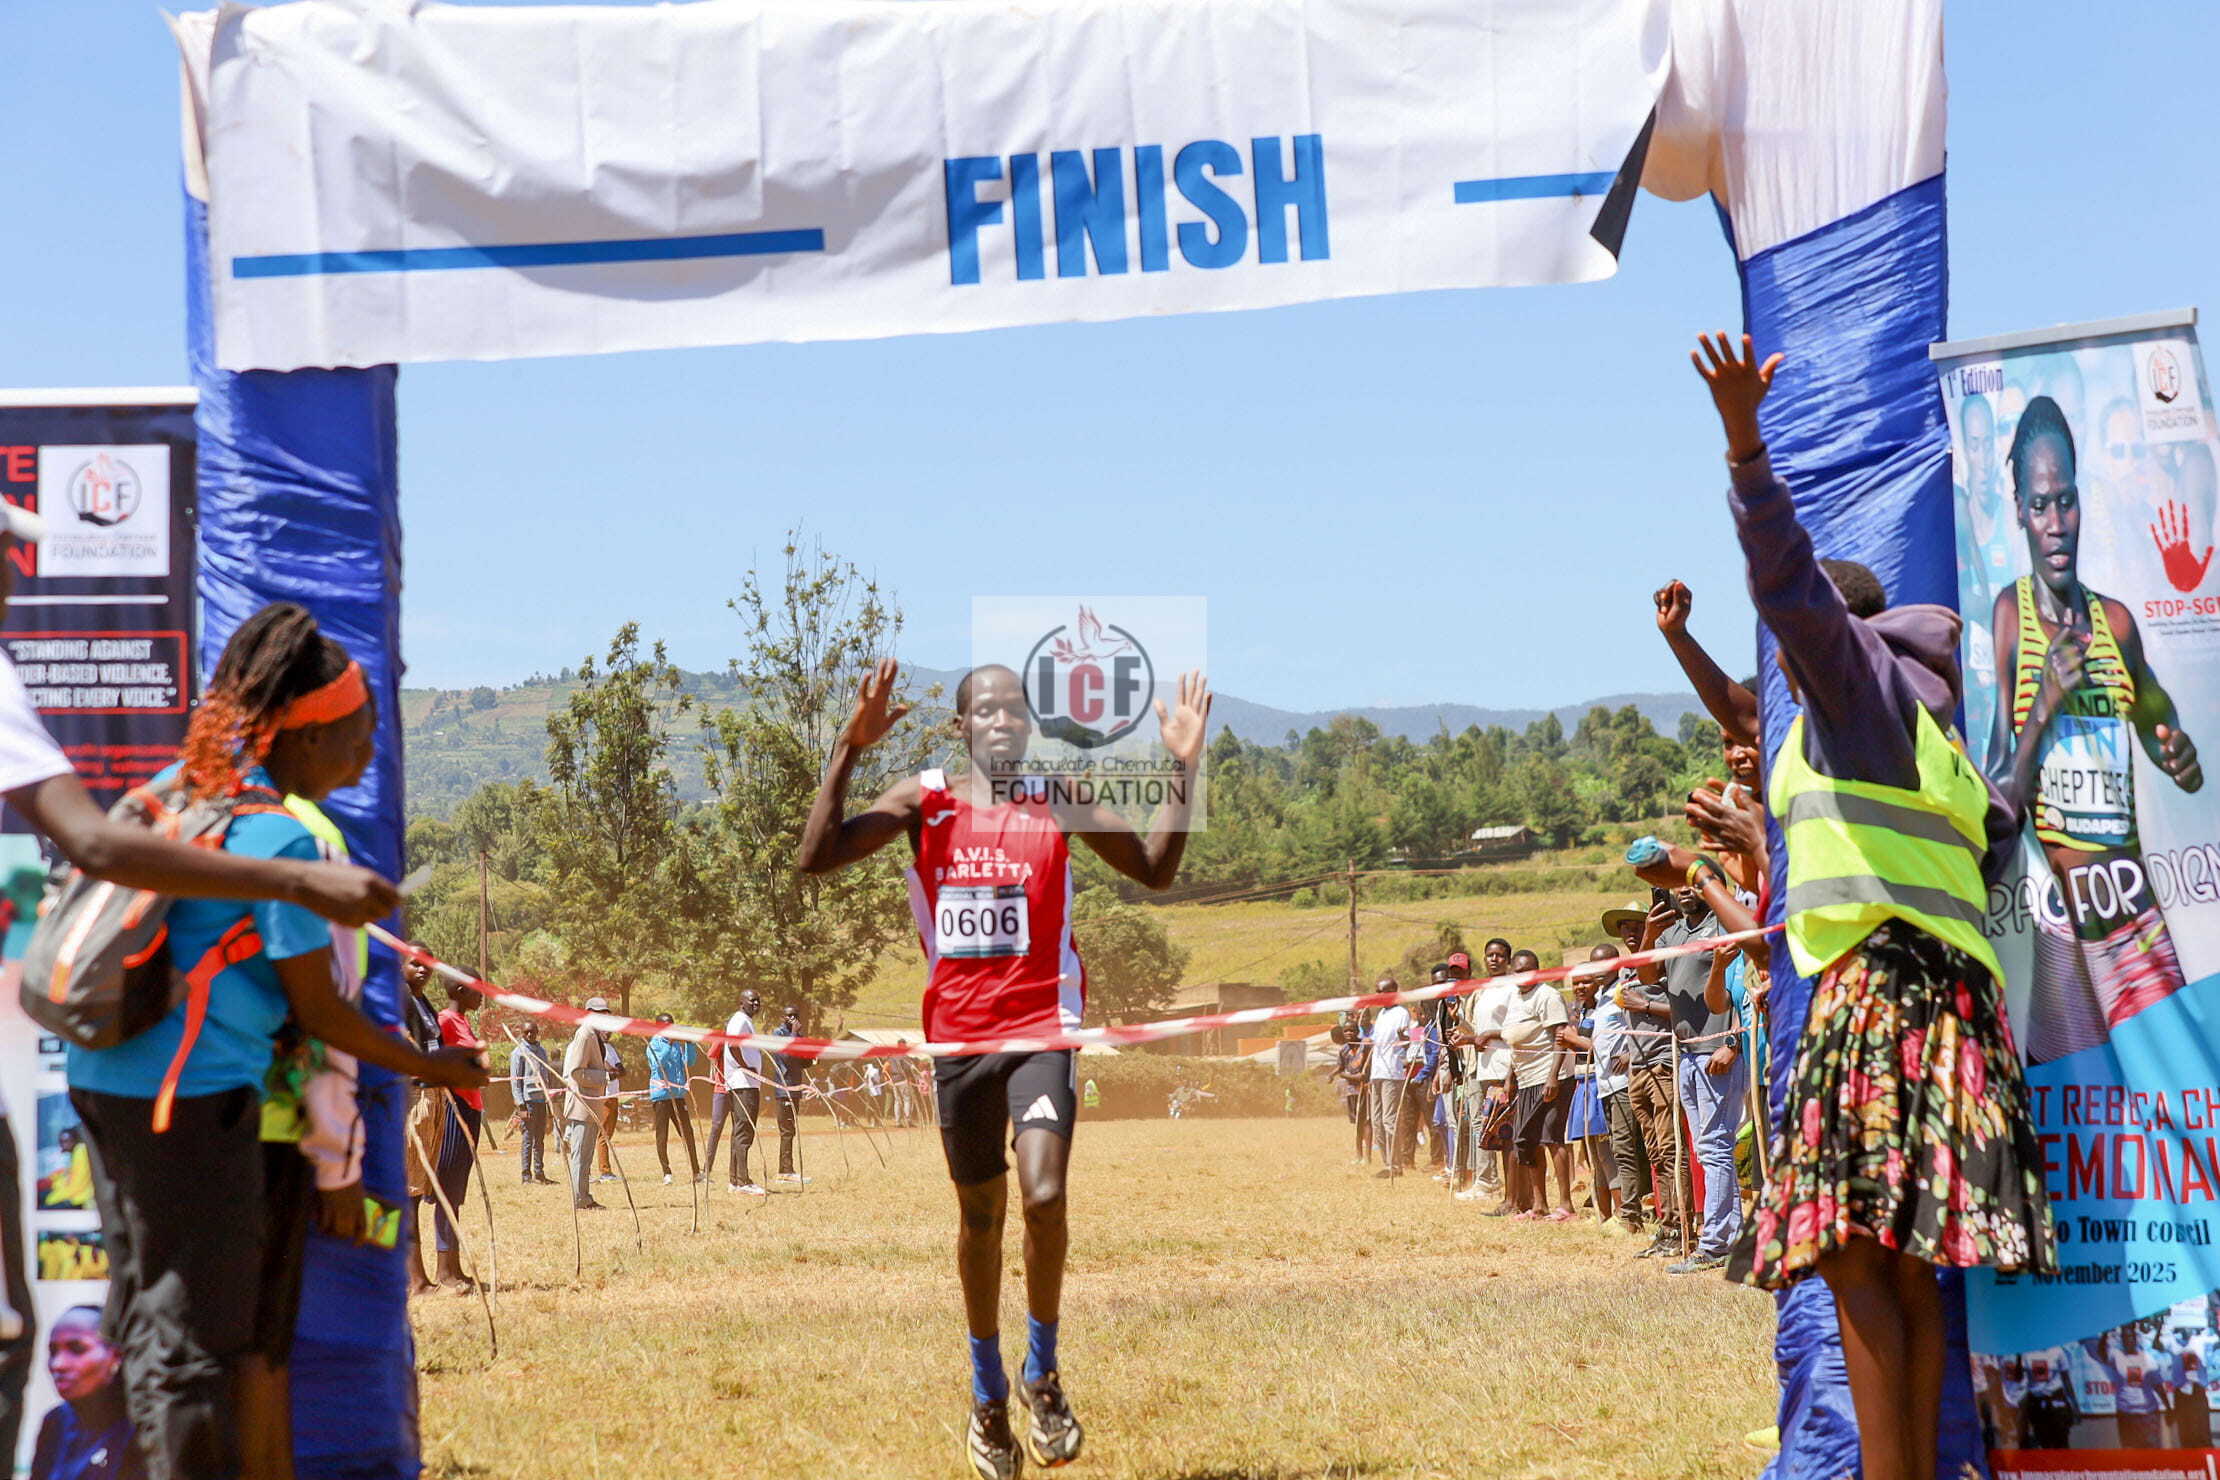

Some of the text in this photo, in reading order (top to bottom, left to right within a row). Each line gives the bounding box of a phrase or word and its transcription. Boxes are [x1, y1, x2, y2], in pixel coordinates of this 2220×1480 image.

[944, 133, 1331, 286] FINISH
[1960, 366, 2005, 396] Edition
[89, 639, 152, 660] AGAINST
[2068, 857, 2144, 924] FOR
[941, 906, 1019, 937] 0606
[2078, 1215, 2137, 1244] Town
[2127, 1261, 2177, 1284] 2025
